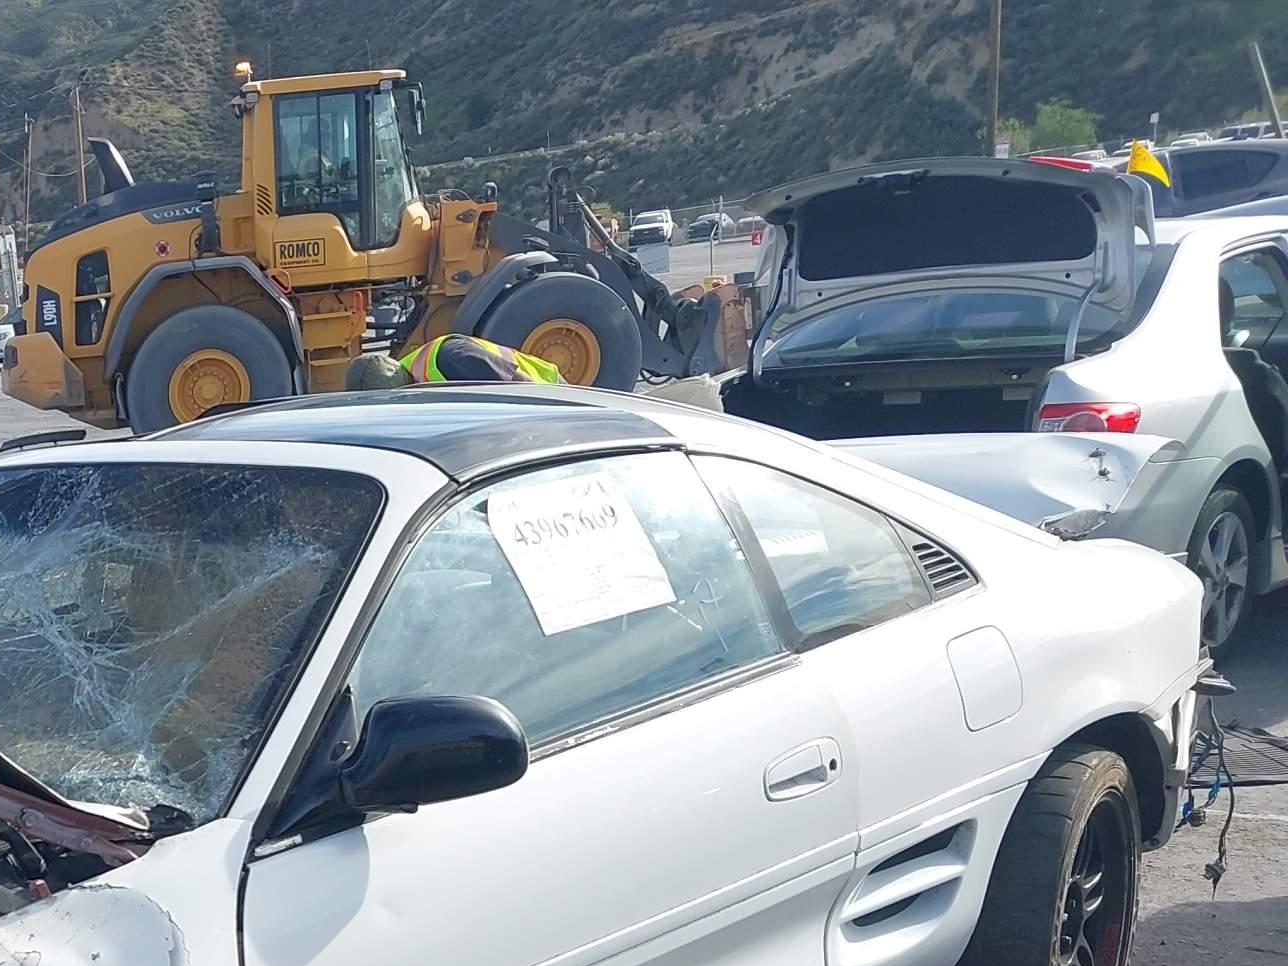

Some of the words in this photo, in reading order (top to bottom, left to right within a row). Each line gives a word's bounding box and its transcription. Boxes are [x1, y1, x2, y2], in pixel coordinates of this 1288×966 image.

[279, 241, 320, 260] ROMCO
[42, 299, 57, 326] L90H
[514, 503, 618, 547] 43967669
